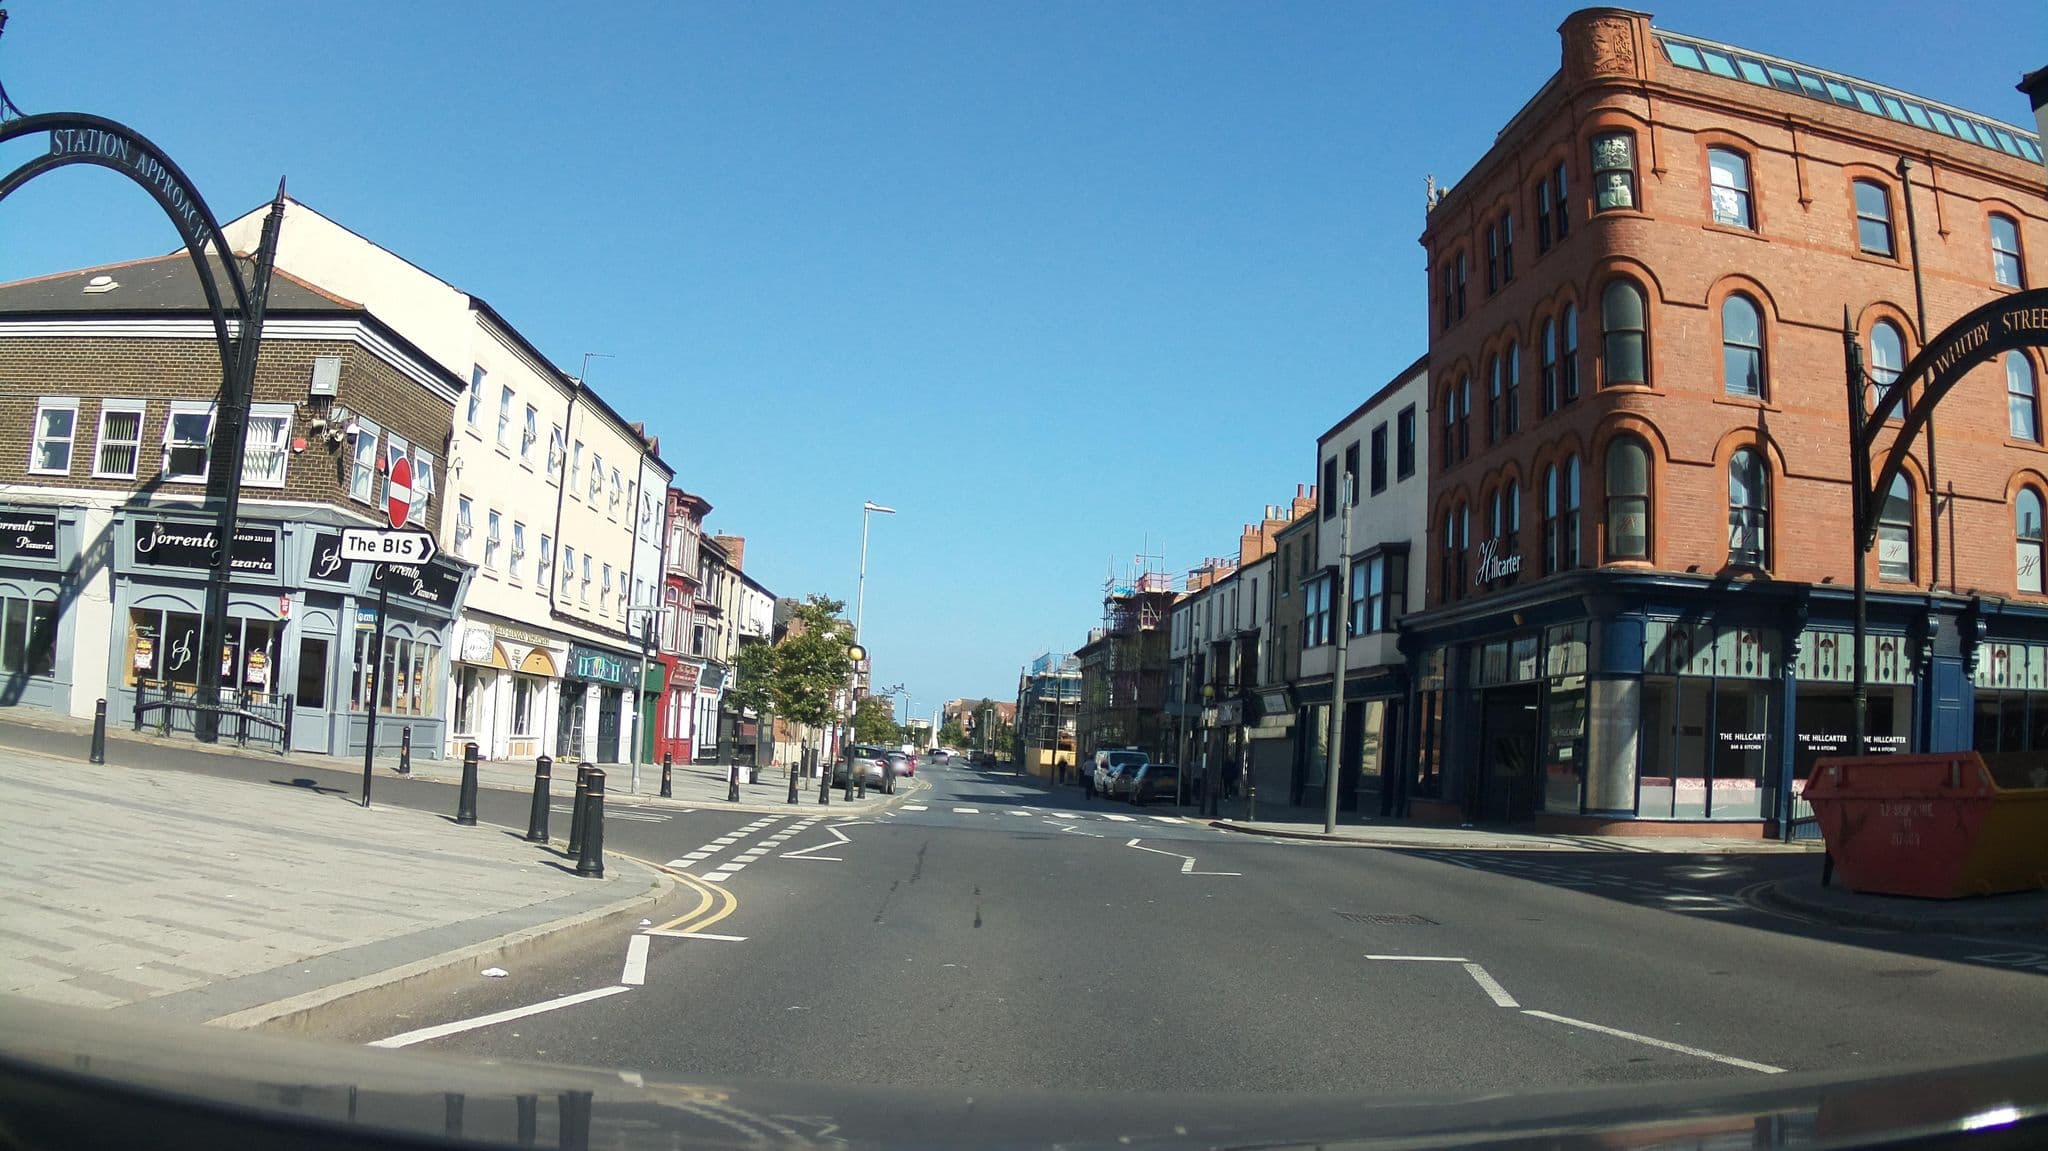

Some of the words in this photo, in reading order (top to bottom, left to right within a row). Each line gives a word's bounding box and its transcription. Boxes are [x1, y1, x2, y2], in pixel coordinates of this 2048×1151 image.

[53, 128, 130, 161] STATION
[135, 152, 211, 247] APPROACH
[1935, 321, 1990, 374] WHITBY
[0, 518, 35, 532] orrento
[349, 536, 376, 552] The
[383, 538, 413, 554] BIS
[210, 550, 273, 570] Pzzaria
[1475, 538, 1520, 586] Hillcarter
[1720, 732, 1734, 742] THE
[1734, 733, 1773, 743] HILLCART
[1799, 733, 1810, 742] THE
[1812, 734, 1847, 742] HILLCARTER
[1873, 736, 1907, 744] HILLCARTER
